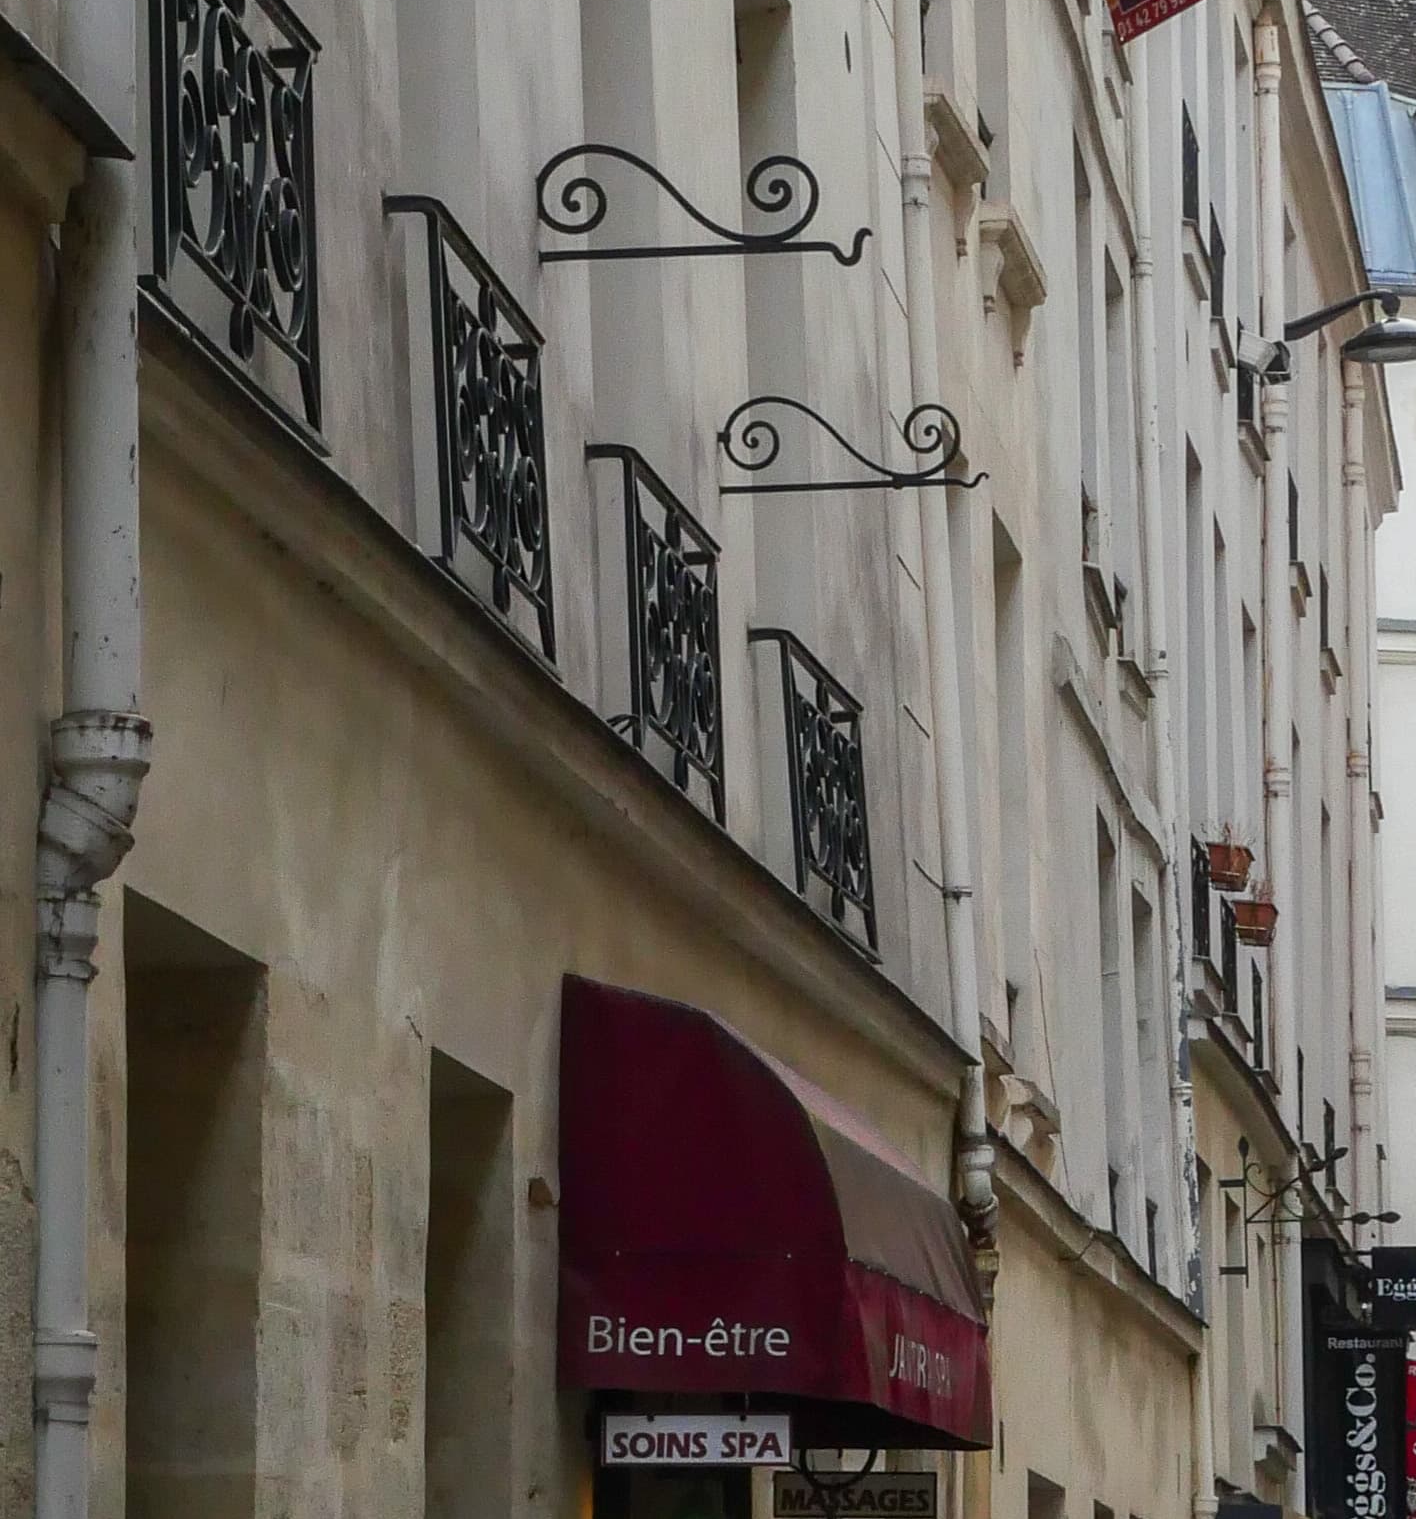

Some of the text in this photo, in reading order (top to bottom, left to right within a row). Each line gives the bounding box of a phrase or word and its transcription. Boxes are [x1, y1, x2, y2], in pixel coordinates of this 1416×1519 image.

[587, 1315, 790, 1357] Bien-être
[1327, 1337, 1403, 1349] Restaurant
[611, 1432, 784, 1459] SOINS SPA
